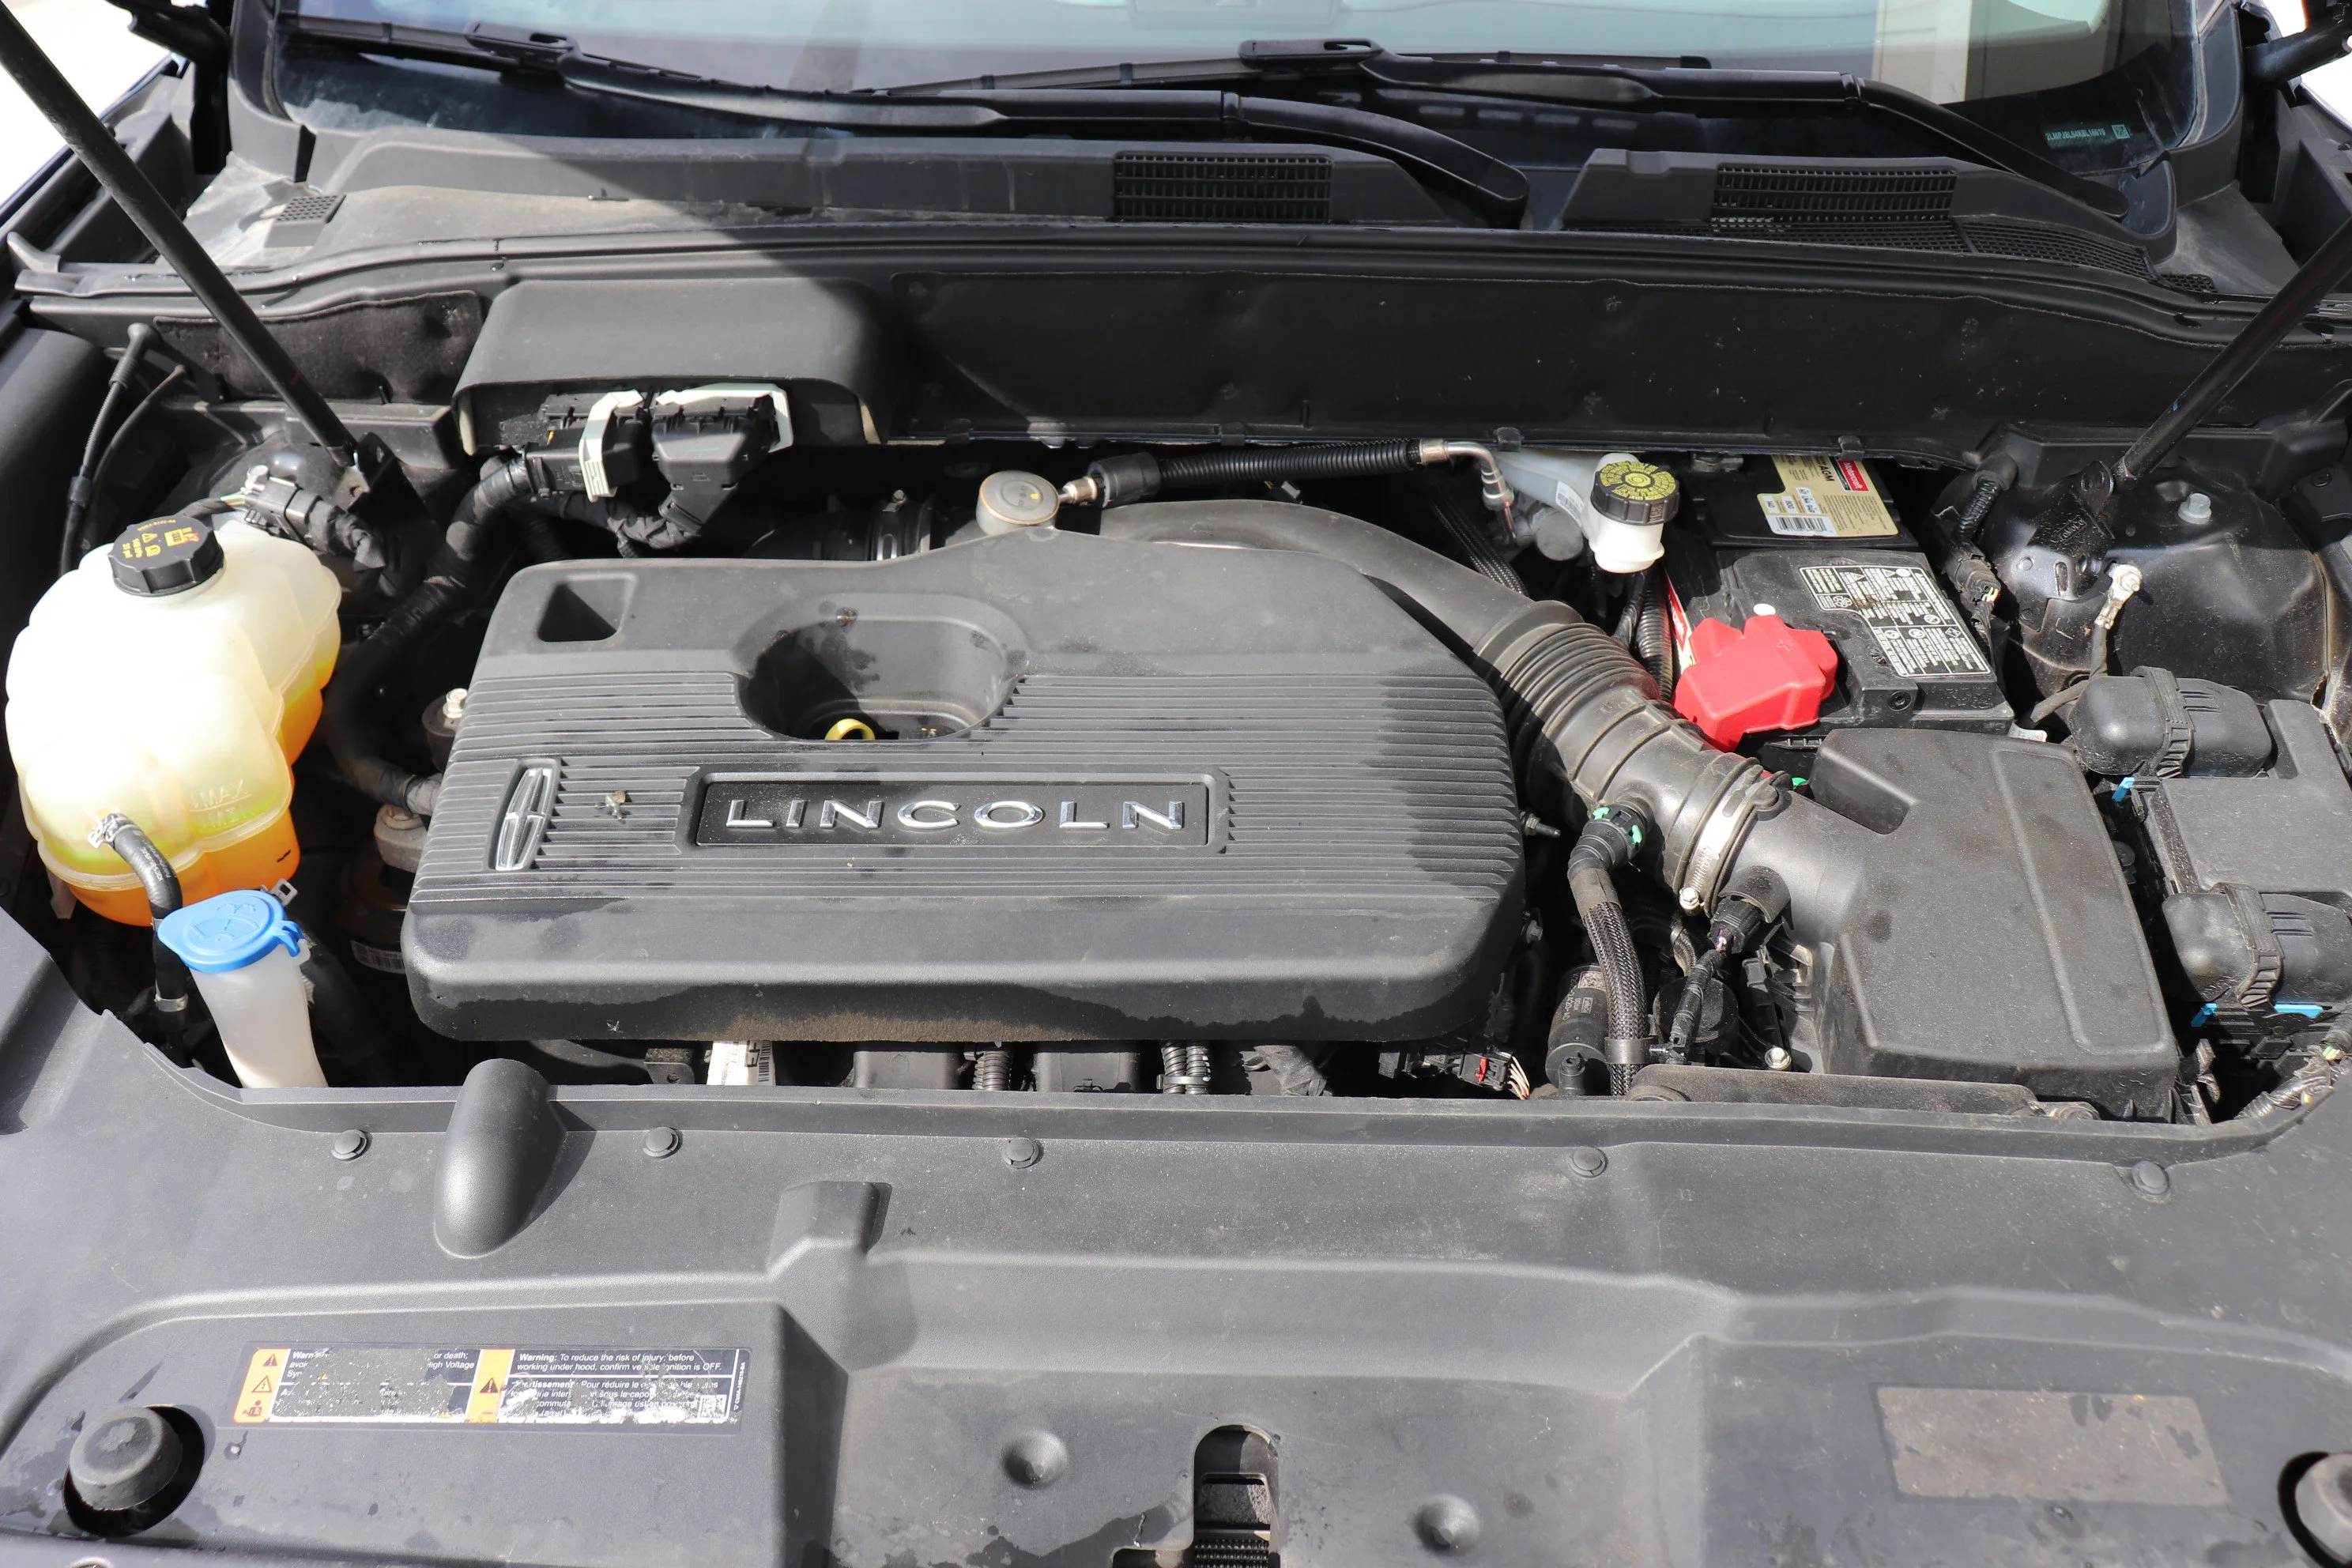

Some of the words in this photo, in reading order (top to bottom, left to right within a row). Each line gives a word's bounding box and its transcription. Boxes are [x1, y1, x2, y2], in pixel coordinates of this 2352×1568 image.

[1819, 465, 1835, 482] AGM
[1842, 462, 1864, 489] Motorcraft
[726, 798, 1185, 830] LINCOLN
[519, 1353, 558, 1363] Warning:
[445, 1361, 475, 1370] Voltage
[517, 1363, 548, 1372] working
